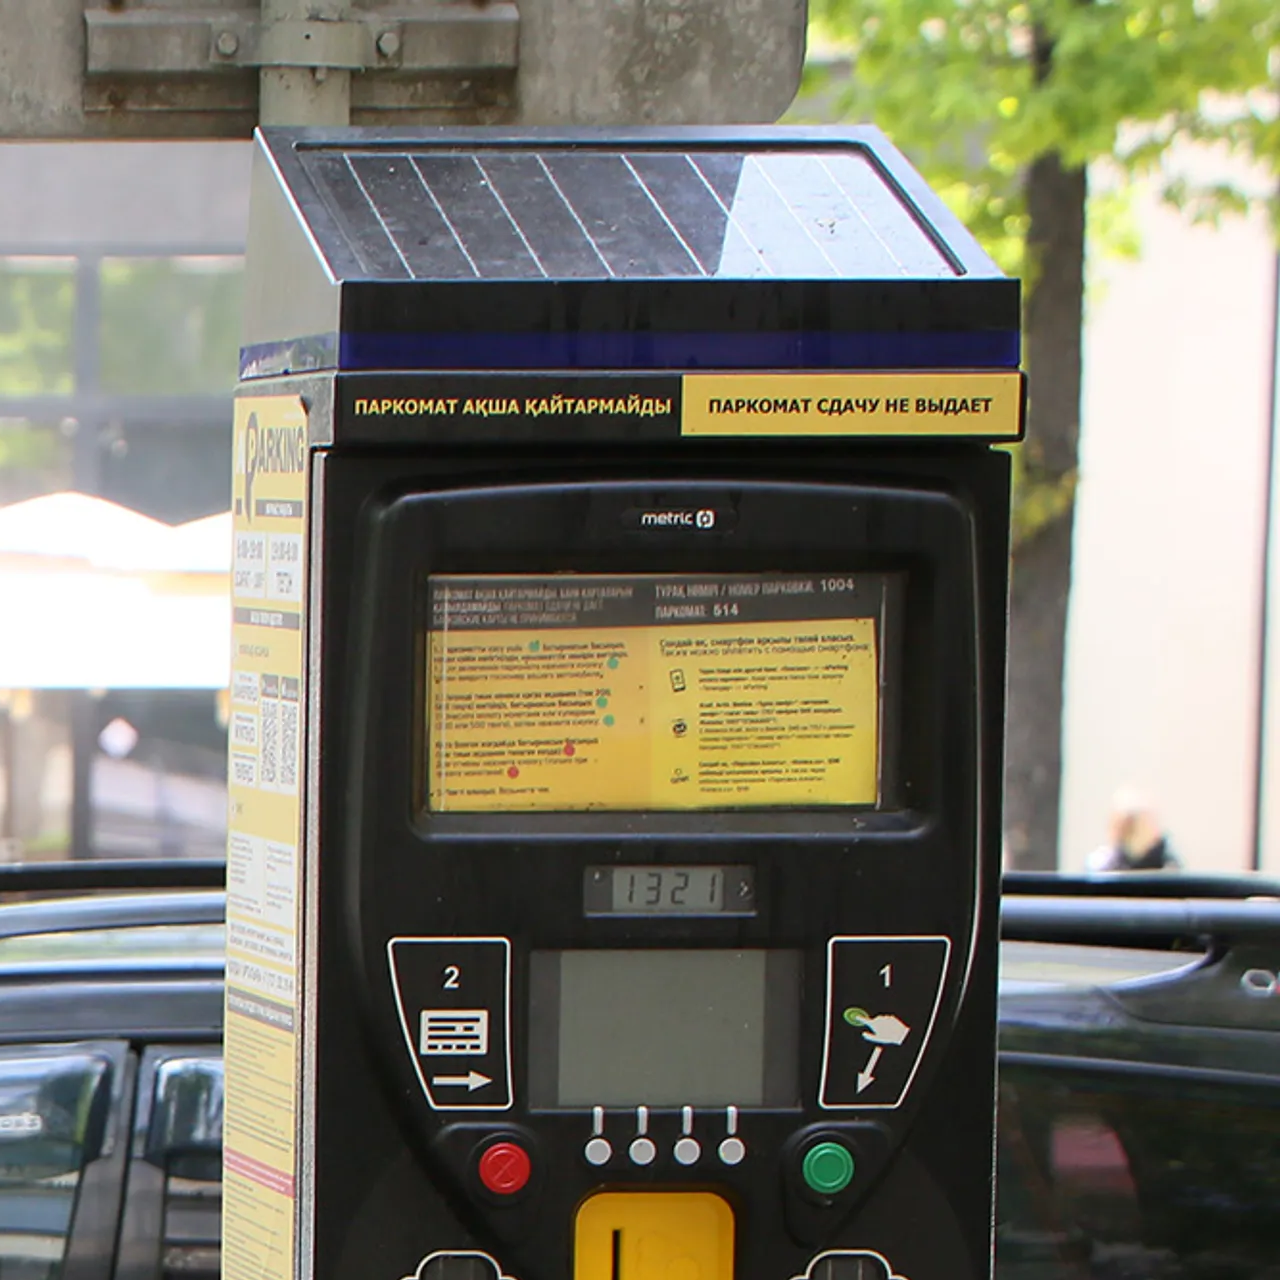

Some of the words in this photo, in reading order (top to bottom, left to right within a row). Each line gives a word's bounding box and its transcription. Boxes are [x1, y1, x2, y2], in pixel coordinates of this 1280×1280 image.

[354, 398, 458, 415] ПАРКОМАТ
[462, 398, 519, 417] АҚША
[525, 394, 671, 417] ҚАЙТАРМАЙДЫ
[708, 398, 812, 414] ПАРКОМАТ
[817, 398, 880, 416] СДАЧУ
[886, 398, 909, 414] НЕ
[915, 397, 993, 415] ВЫДАЕТ
[641, 511, 694, 525] metric
[820, 578, 855, 593] 1004
[443, 964, 460, 988] 2
[878, 963, 892, 987] 1
